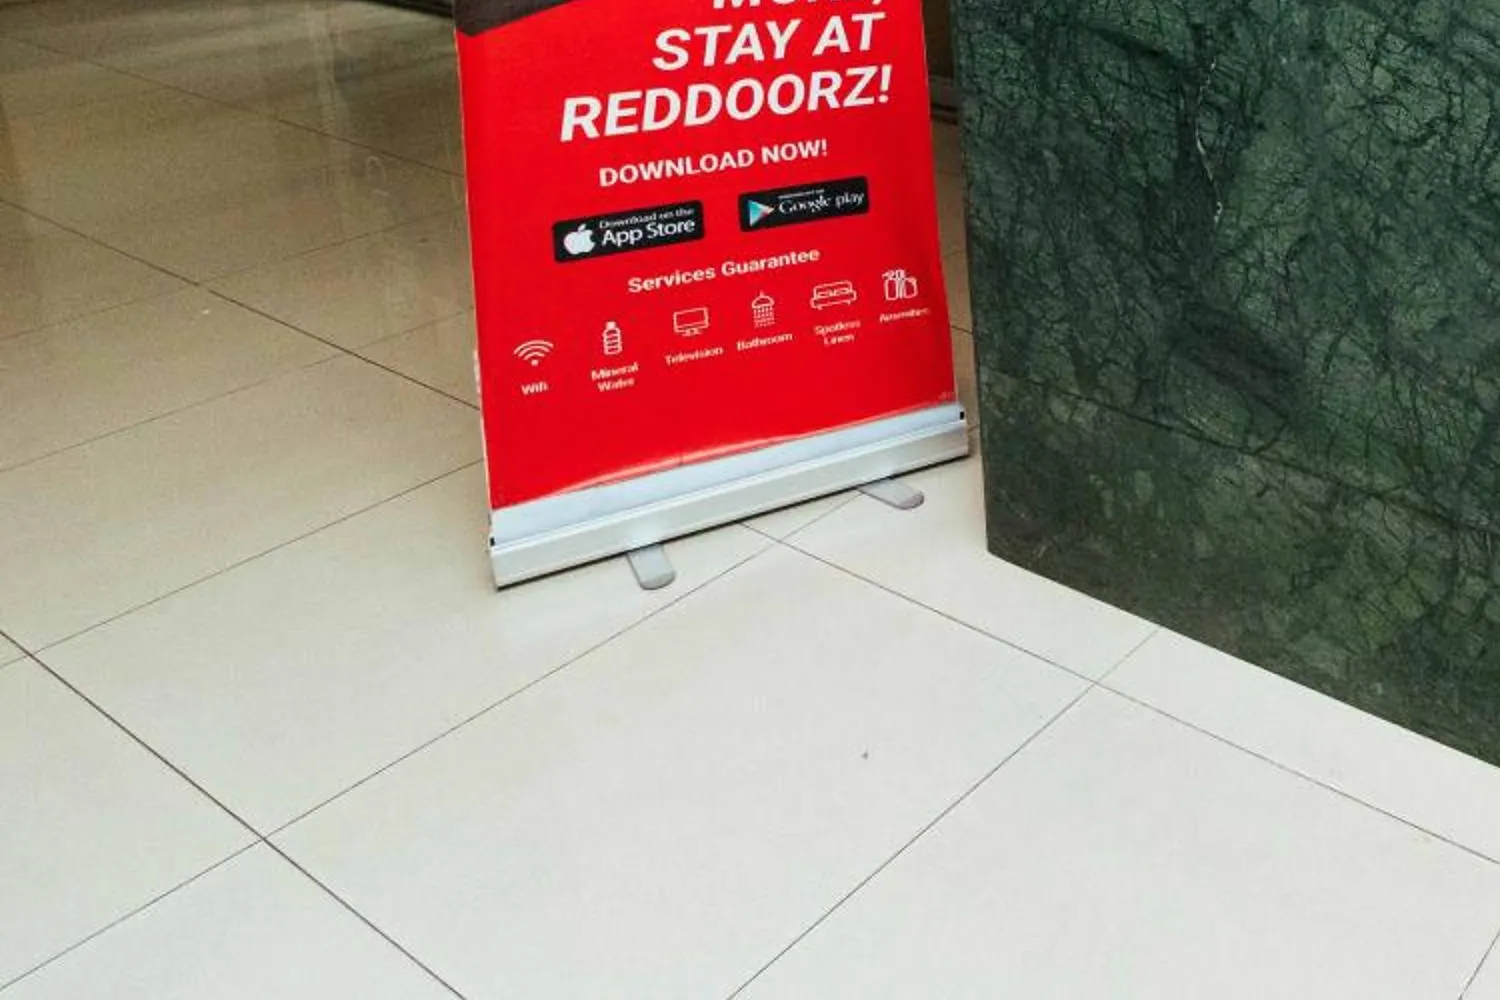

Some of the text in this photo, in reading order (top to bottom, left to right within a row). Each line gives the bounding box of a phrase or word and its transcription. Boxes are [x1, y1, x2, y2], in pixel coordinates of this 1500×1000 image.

[651, 11, 887, 71] STAY AT
[559, 63, 893, 142] REDDOORZ!
[599, 138, 828, 187] DOWNLOAD NOW!
[779, 194, 832, 213] Google
[599, 207, 695, 229] Download on the
[601, 219, 696, 247] App Store
[628, 249, 821, 293] Services Guarantee
[736, 332, 793, 352] Bathroom
[665, 346, 724, 366] Television
[591, 361, 639, 381] Mineral
